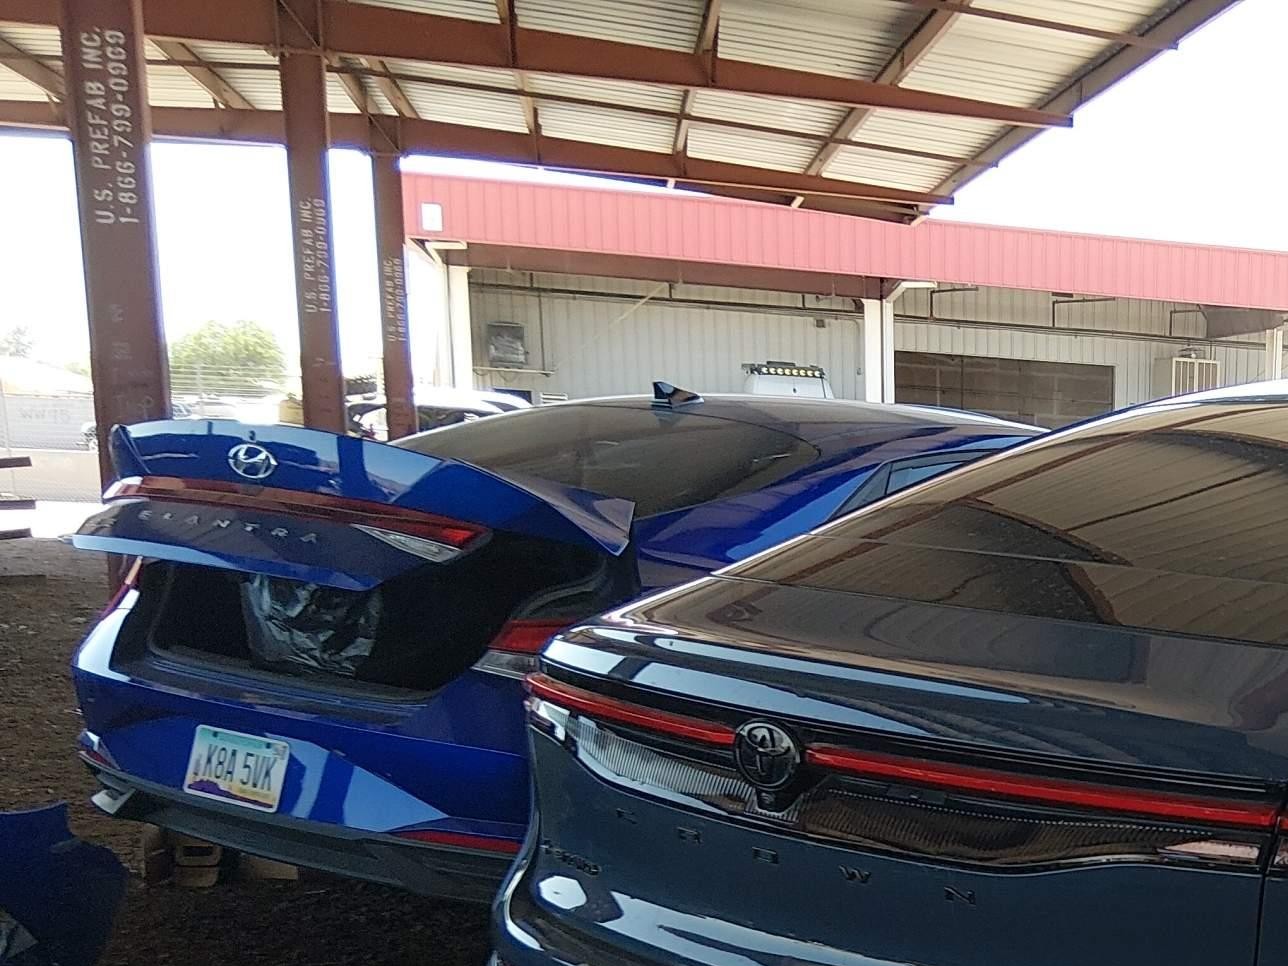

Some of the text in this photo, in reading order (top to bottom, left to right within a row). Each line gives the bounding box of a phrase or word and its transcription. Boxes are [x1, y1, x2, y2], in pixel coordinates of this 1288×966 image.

[84, 79, 112, 170] PREFAB
[104, 29, 140, 224] 1-866-799-0969
[94, 182, 116, 225] U.S.
[137, 509, 319, 545] ELANTRA
[240, 751, 278, 792] 5VK
